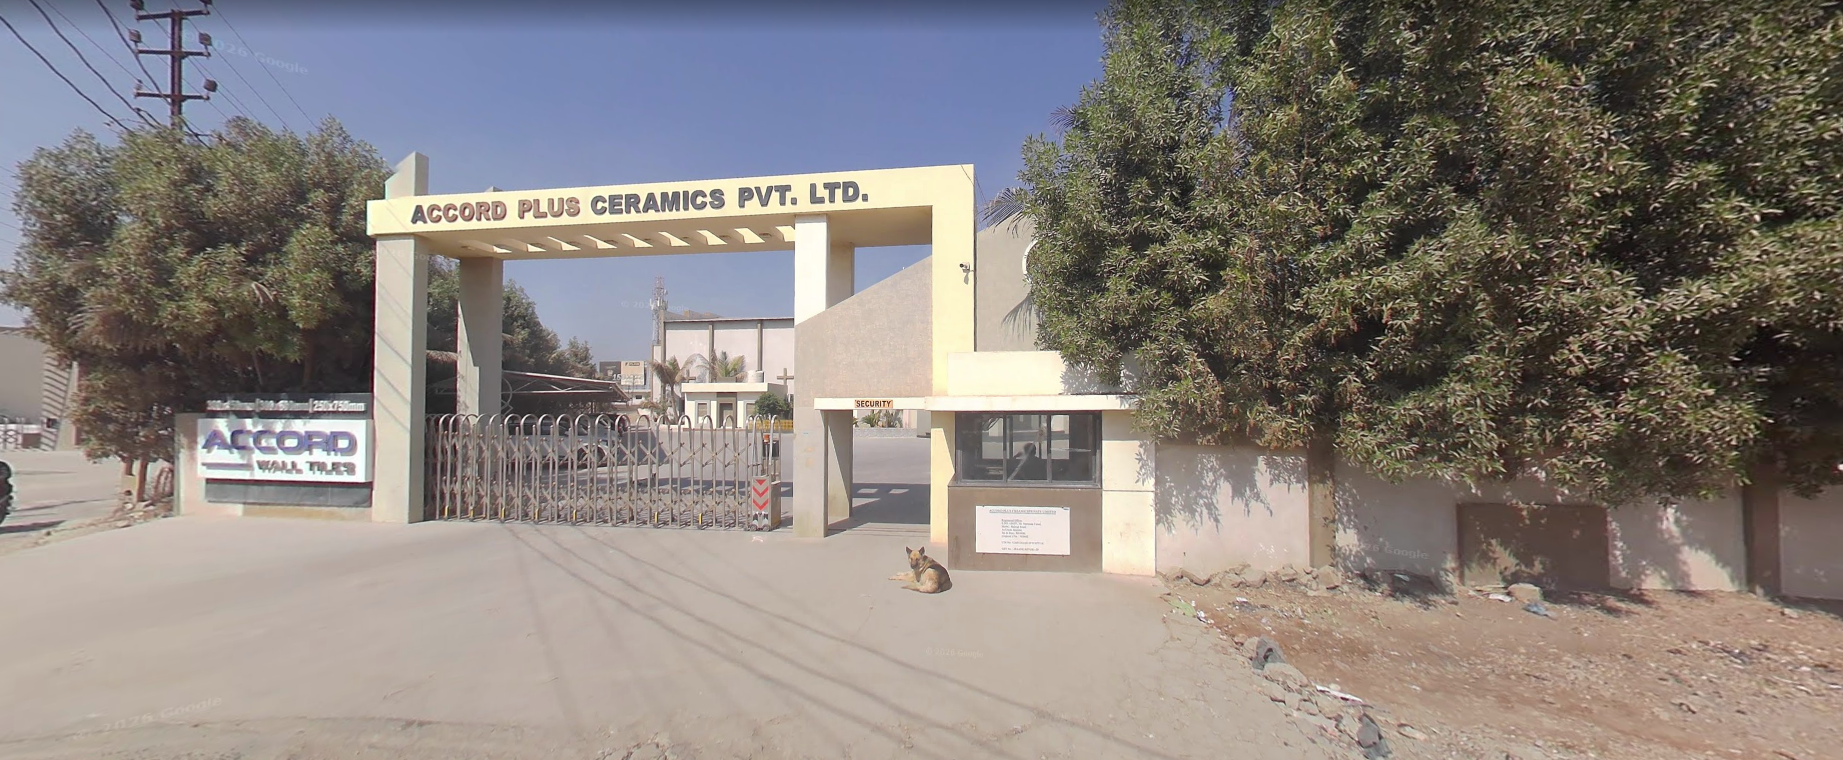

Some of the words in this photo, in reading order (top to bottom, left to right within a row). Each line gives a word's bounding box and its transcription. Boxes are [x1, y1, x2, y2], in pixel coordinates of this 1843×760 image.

[411, 201, 507, 224] ACCORD
[518, 197, 581, 219] PLUS
[591, 188, 726, 216] CERAMICS
[738, 184, 797, 209] PVT.
[810, 181, 869, 204] LTD.
[313, 401, 365, 412] 250x750mm
[202, 429, 358, 457] ACCORD
[256, 460, 303, 475] WALL
[305, 461, 356, 476] TILES
